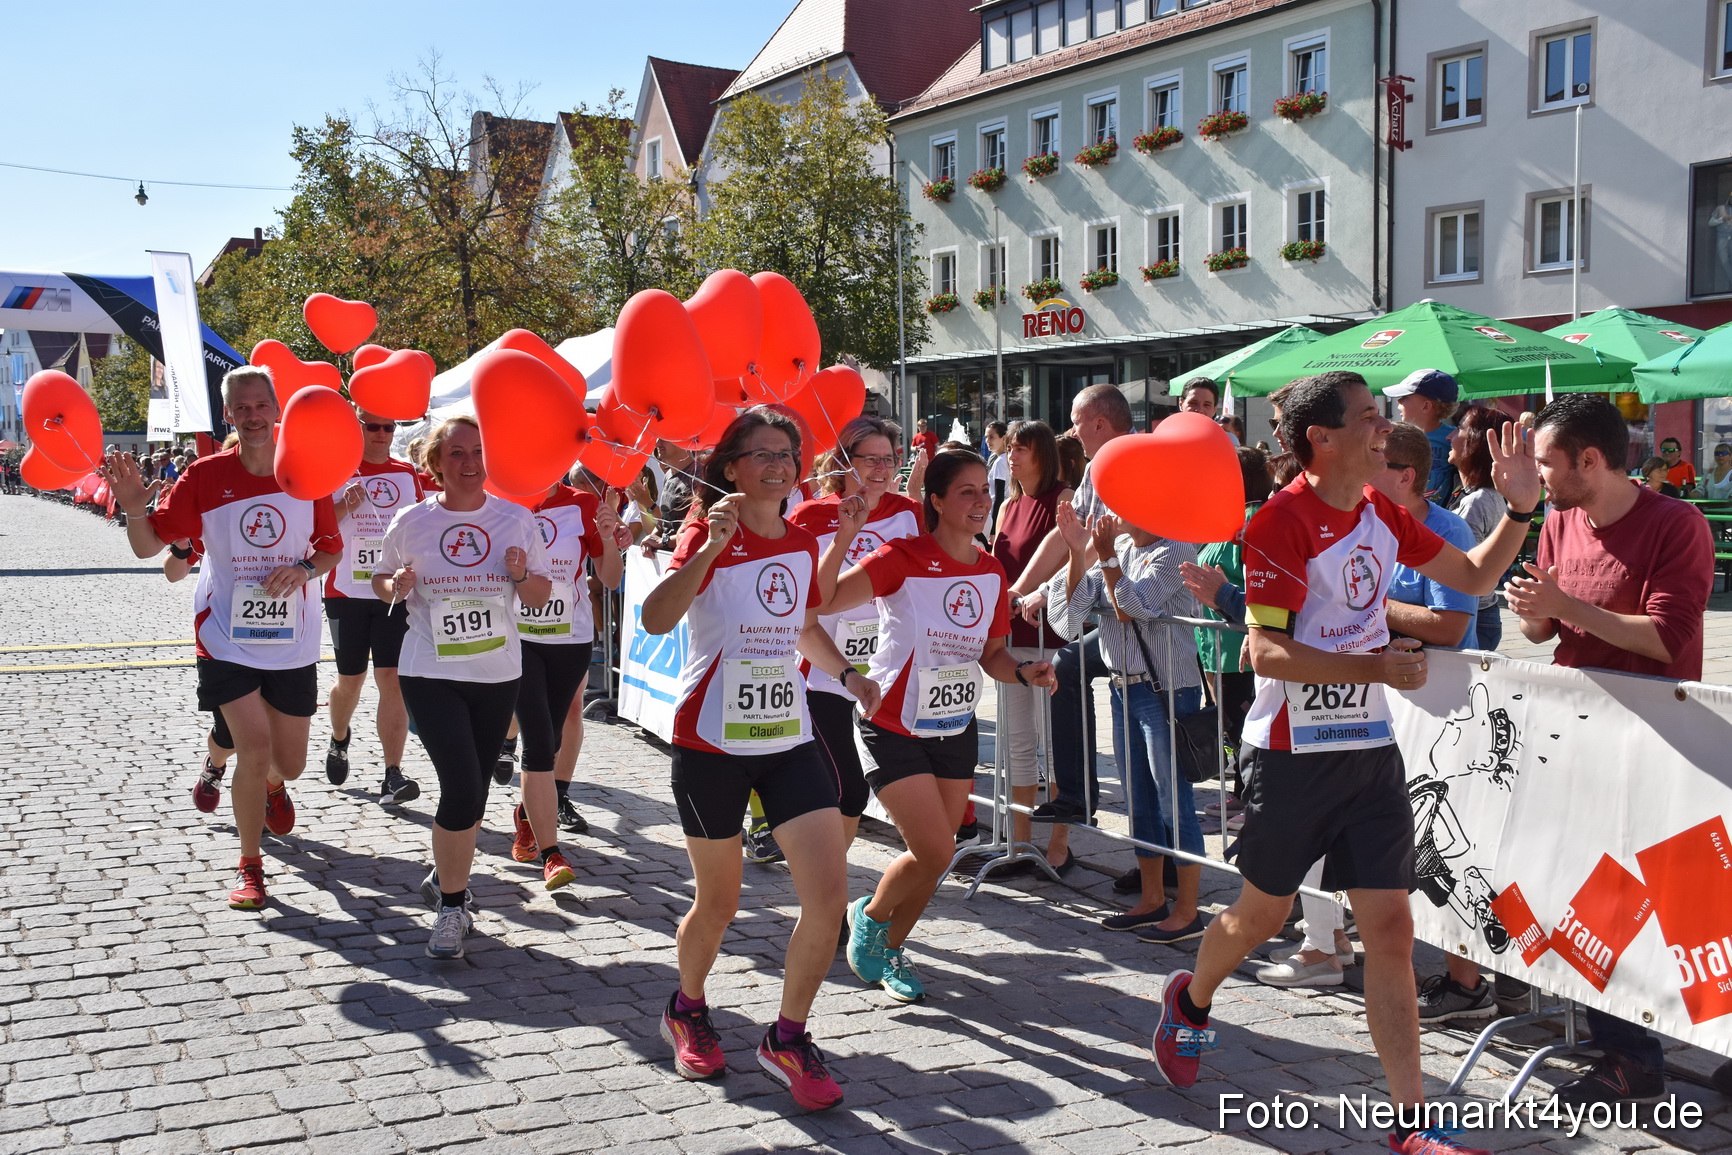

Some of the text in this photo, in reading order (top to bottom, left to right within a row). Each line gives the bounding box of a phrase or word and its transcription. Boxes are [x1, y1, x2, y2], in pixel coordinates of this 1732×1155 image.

[1392, 91, 1401, 141] Achatz
[1022, 307, 1085, 339] RENO
[1327, 351, 1399, 359] Neumarkter
[1303, 358, 1401, 369] Lammsbräu
[231, 555, 258, 563] AUFEN
[277, 554, 294, 563] HER
[551, 558, 573, 566] HERZ
[423, 576, 459, 585] LAUFEN
[486, 573, 510, 583] HERZ
[1265, 570, 1277, 579] für
[242, 600, 288, 619] 2344
[451, 599, 484, 609] BOCK
[443, 609, 492, 636] 5191
[740, 624, 772, 634] LAUFEN
[250, 629, 279, 639] Rüdiger
[528, 626, 556, 635] Carmen
[927, 628, 959, 641] LAUFEN
[1321, 623, 1362, 638] LAUFEN
[844, 636, 878, 657] 520
[752, 665, 785, 676] BOCK
[938, 669, 969, 679] BOCK
[738, 681, 793, 710] 5166
[929, 681, 976, 708] 2638
[1302, 683, 1370, 711] 2627
[937, 718, 964, 729] Sevinc
[749, 725, 784, 738] Claudia
[1314, 727, 1369, 740] Johannes
[1709, 832, 1731, 870] Seit 1929
[1633, 910, 1643, 921] Seit
[1513, 923, 1542, 953] Braun
[1555, 904, 1613, 971] Braun
[1571, 947, 1587, 964] Sicher
[1586, 960, 1594, 970] ist
